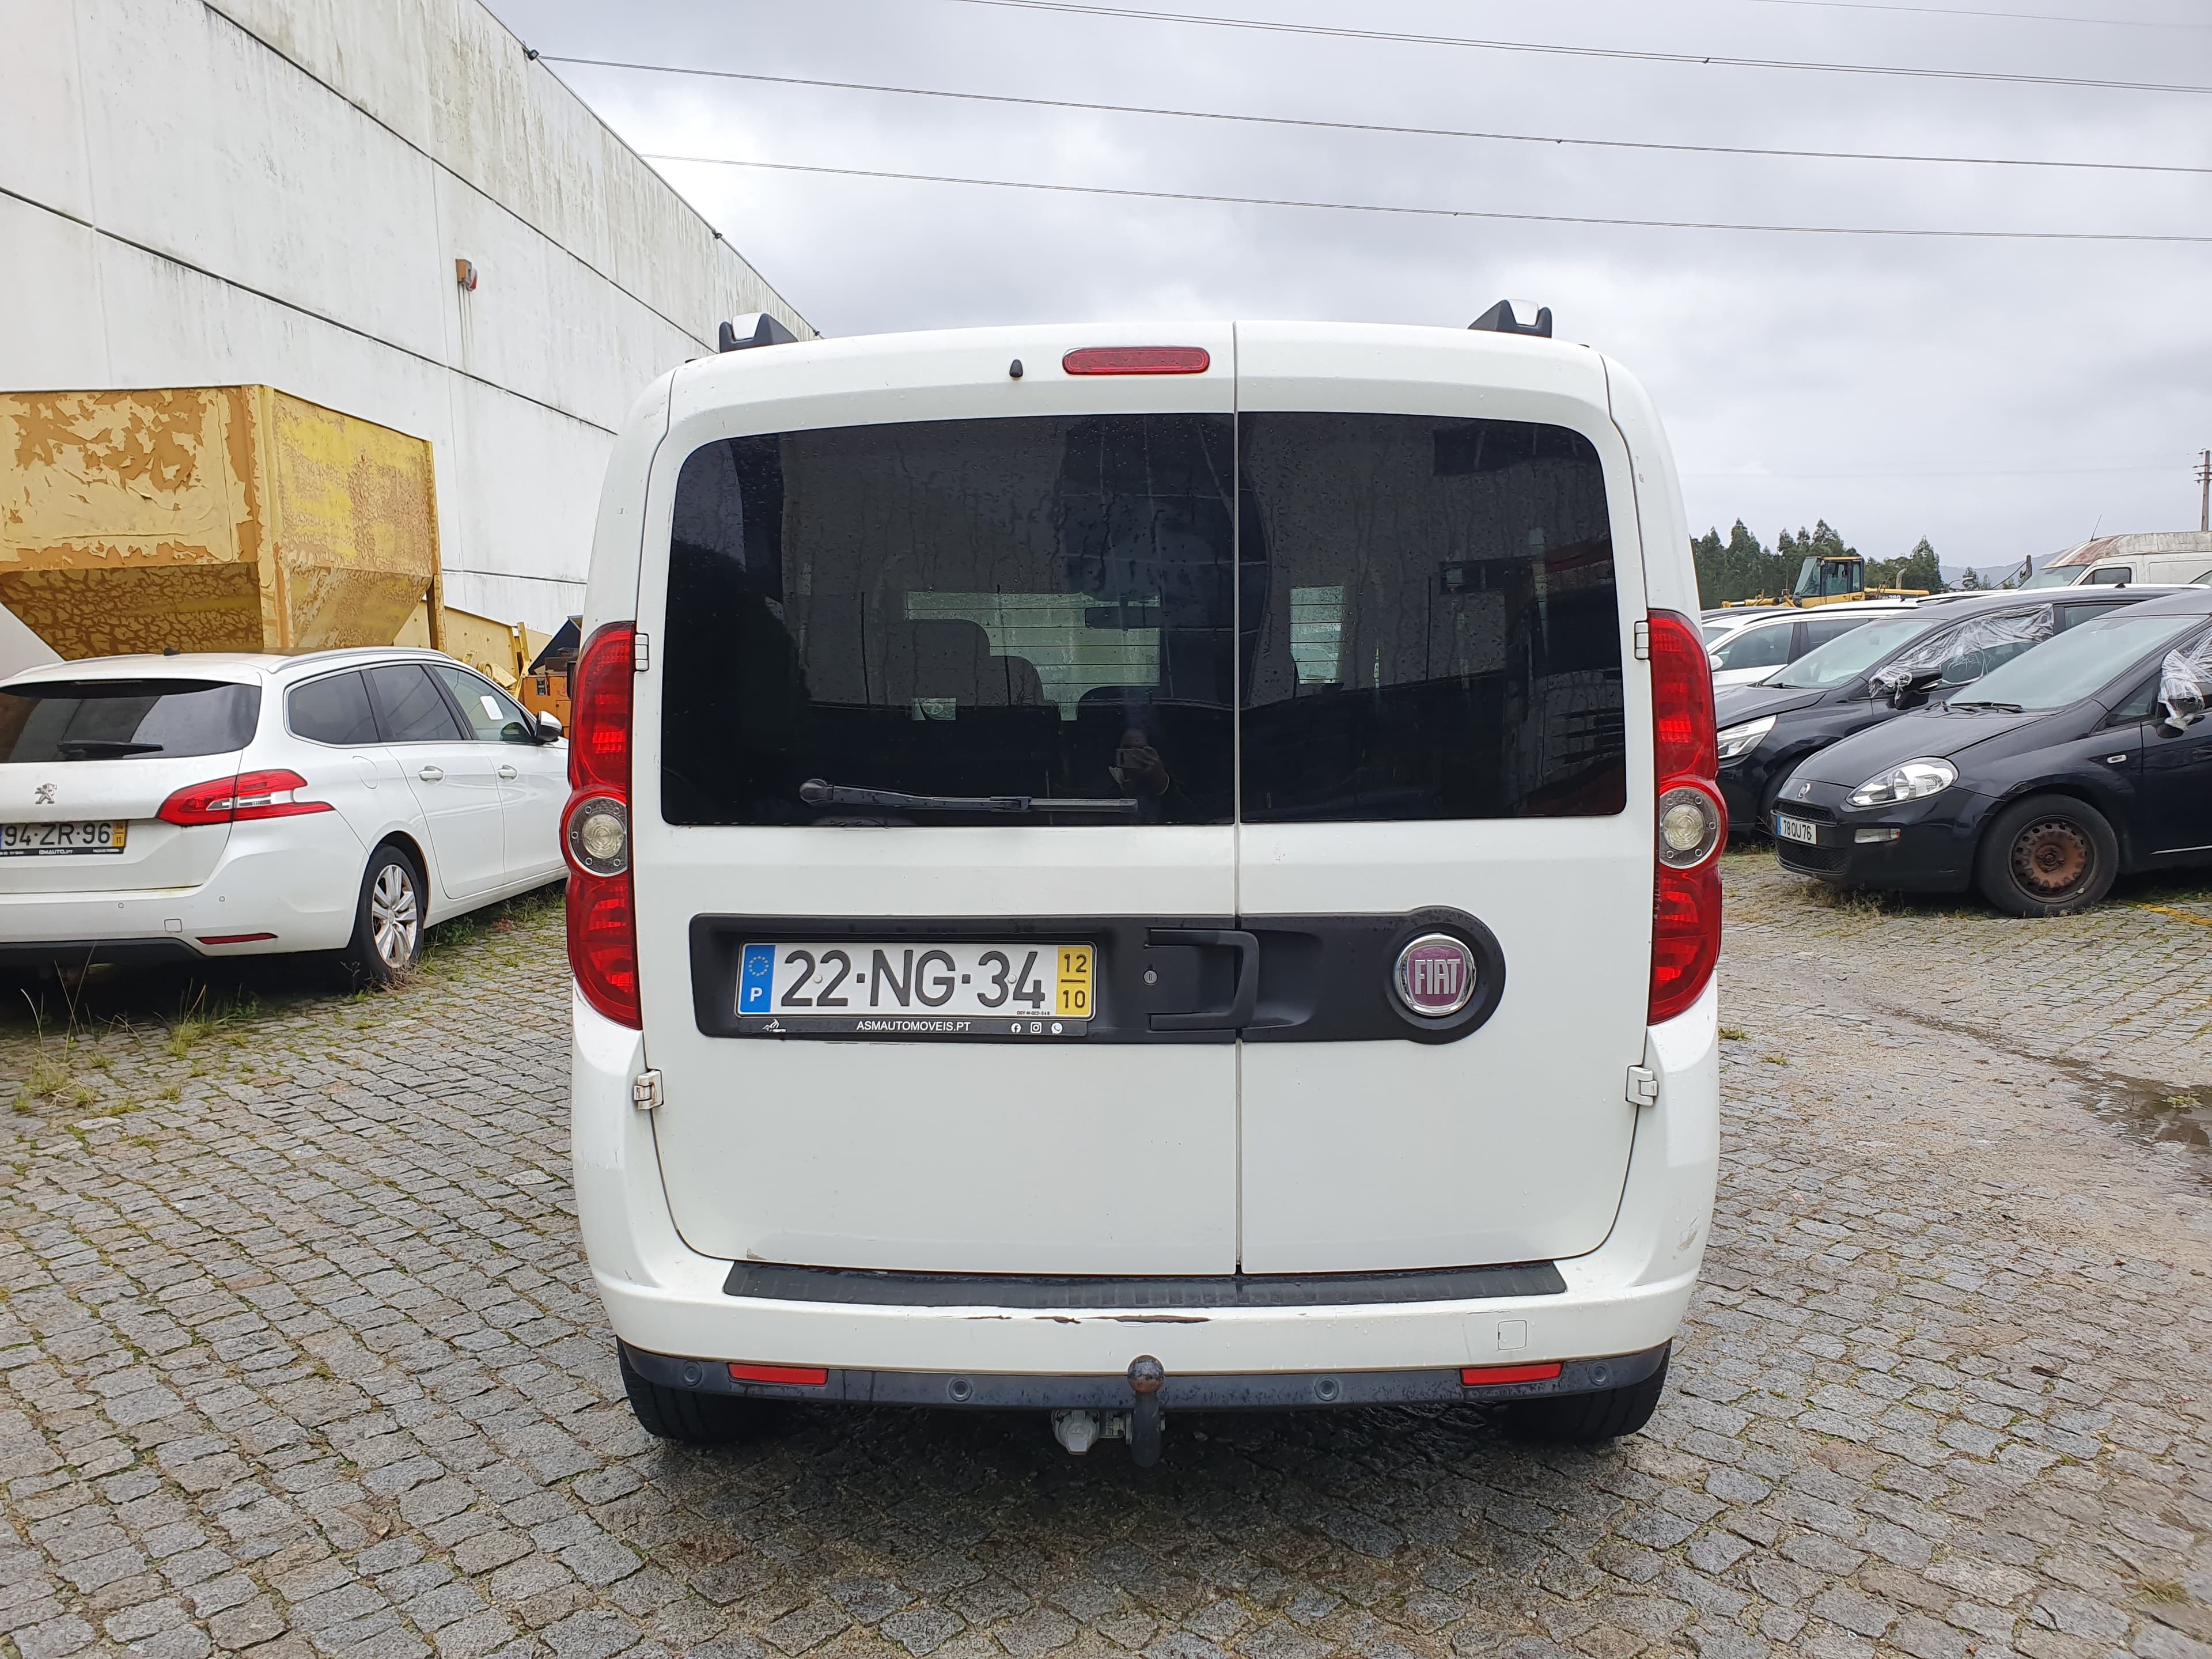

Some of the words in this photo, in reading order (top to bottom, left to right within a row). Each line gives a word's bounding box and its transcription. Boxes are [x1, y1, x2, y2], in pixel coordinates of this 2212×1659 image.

[1783, 820, 1812, 840] 78QU76
[1064, 954, 1087, 973] 12
[1415, 959, 1461, 995] FIAT
[750, 987, 763, 1002] P
[1063, 990, 1086, 1008] 10
[856, 1021, 971, 1032] ASMAUTOMOVEIS.PT
